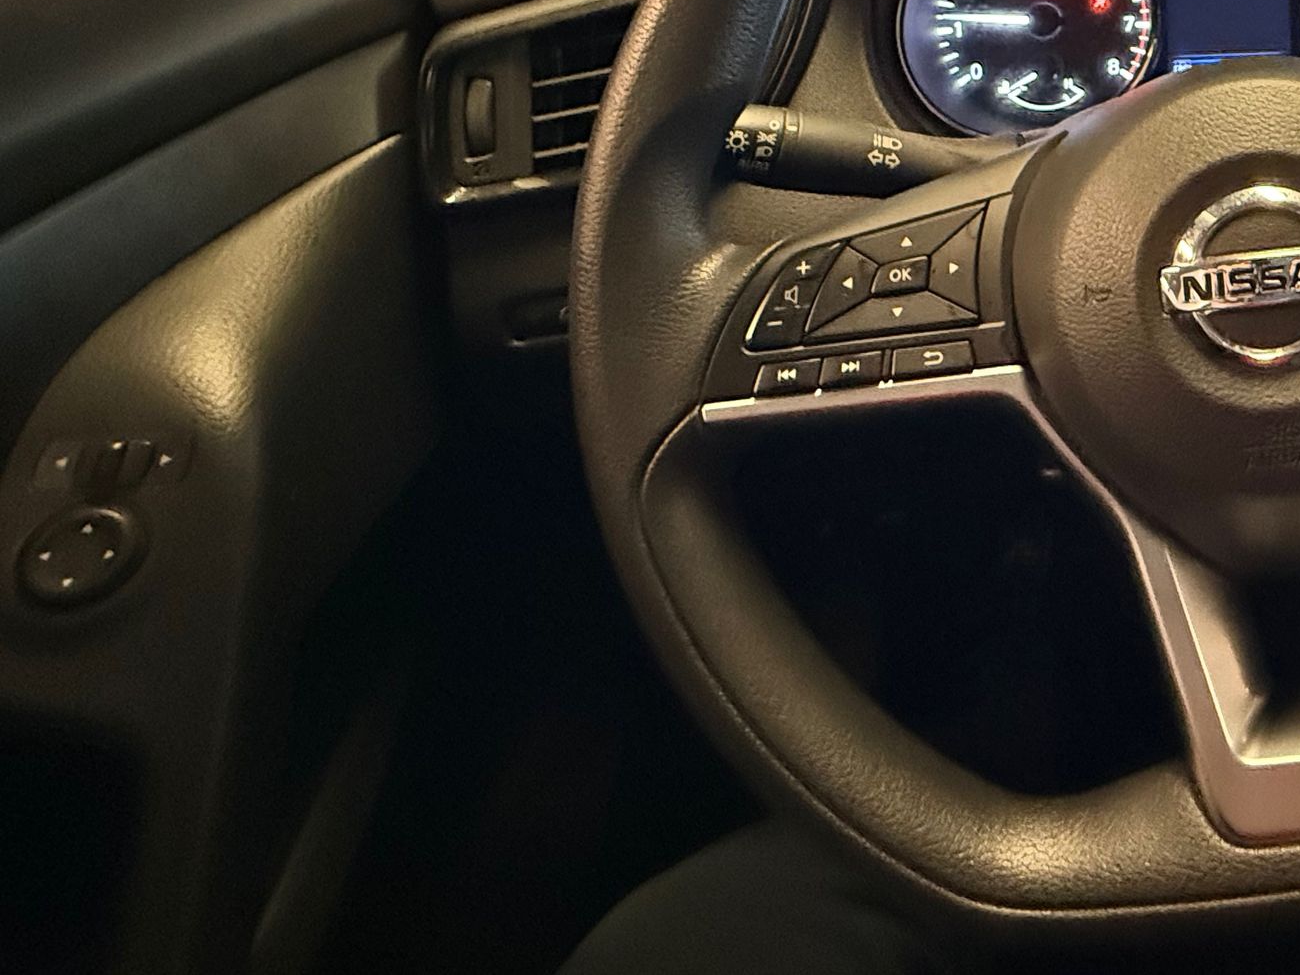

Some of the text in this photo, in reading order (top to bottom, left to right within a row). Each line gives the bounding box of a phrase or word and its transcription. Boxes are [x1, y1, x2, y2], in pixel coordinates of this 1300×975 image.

[954, 20, 963, 38] 1
[1123, 15, 1136, 33] 7
[970, 62, 984, 81] 0
[1107, 57, 1121, 76] 8
[889, 268, 913, 283] OK
